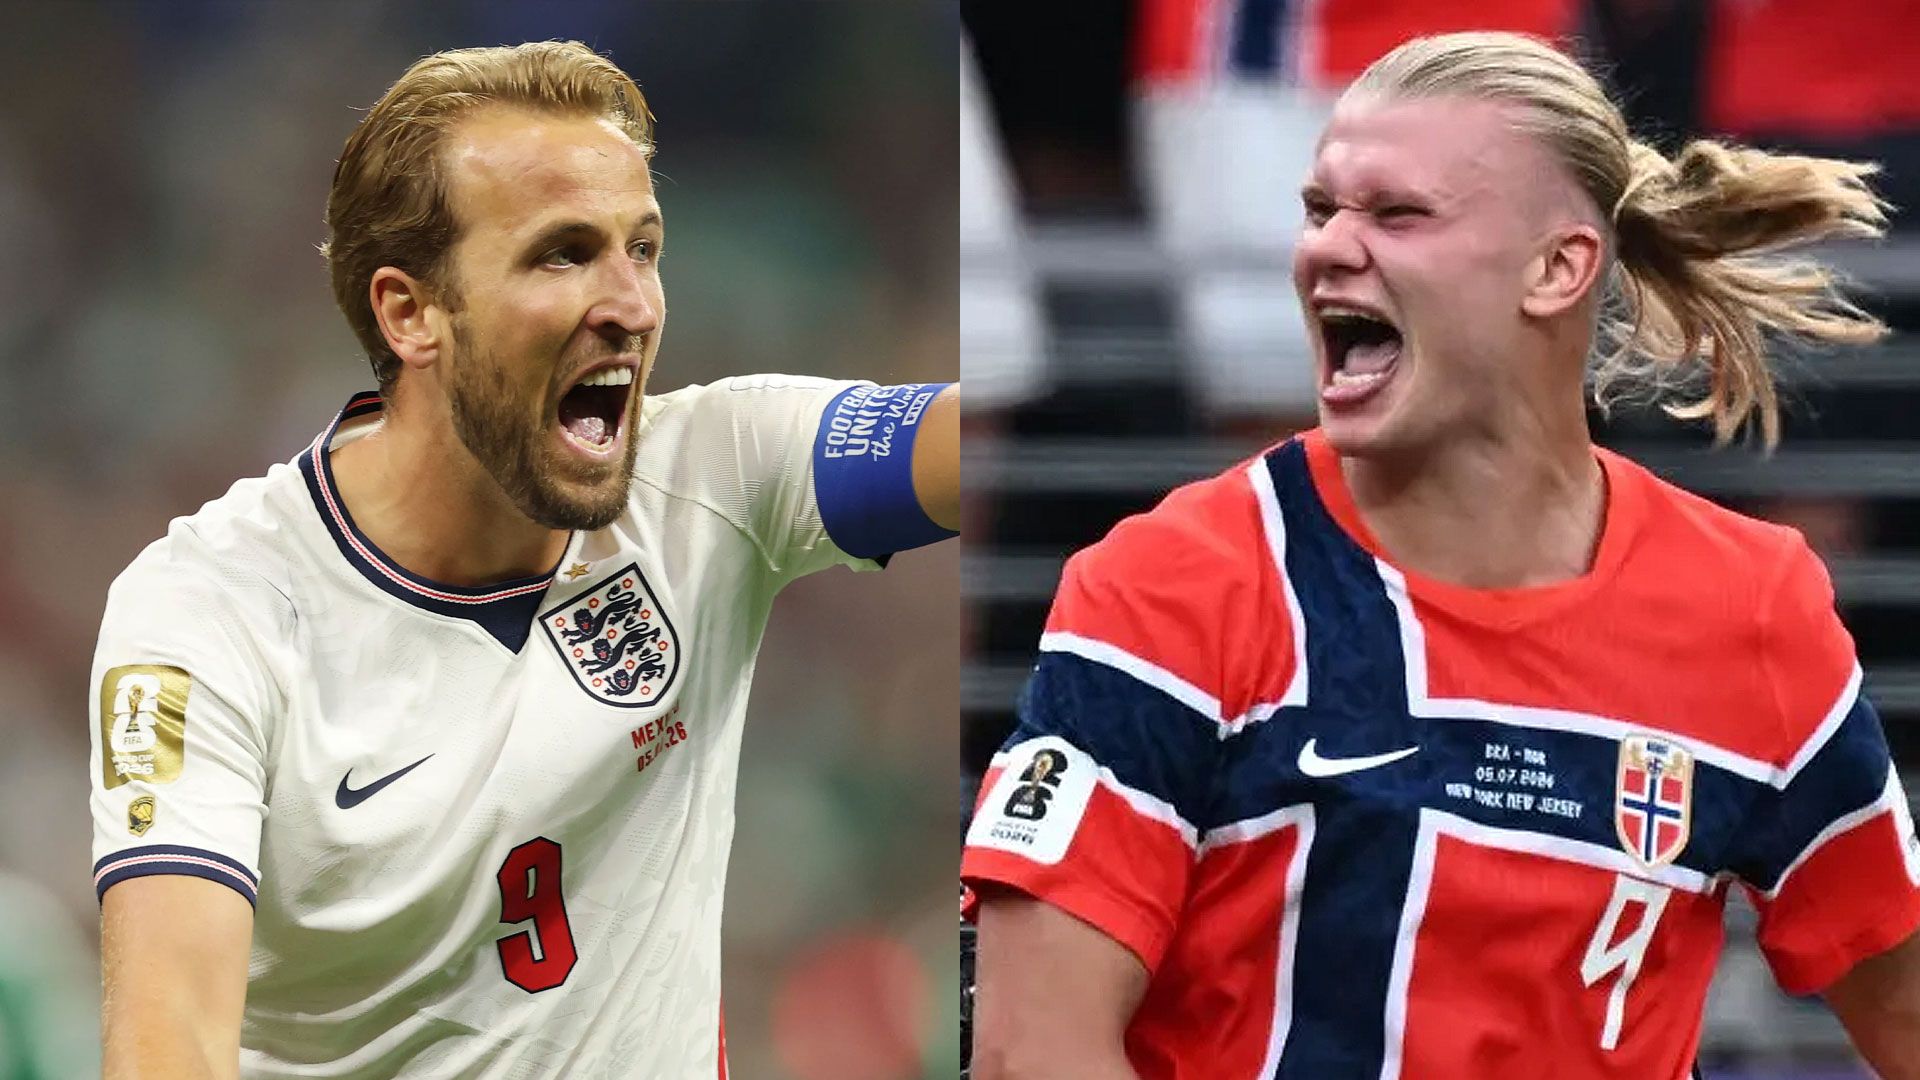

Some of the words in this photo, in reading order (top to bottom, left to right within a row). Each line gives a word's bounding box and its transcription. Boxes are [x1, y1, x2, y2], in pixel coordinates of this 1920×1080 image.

[824, 385, 878, 459] FOOTBA
[870, 422, 896, 462] the
[123, 735, 142, 745] FIFA
[1485, 743, 1510, 761] BRA
[1506, 791, 1536, 811] NEW
[1537, 796, 1583, 819] JERSEY
[496, 835, 579, 995] 9
[1580, 872, 1673, 1051] 9
